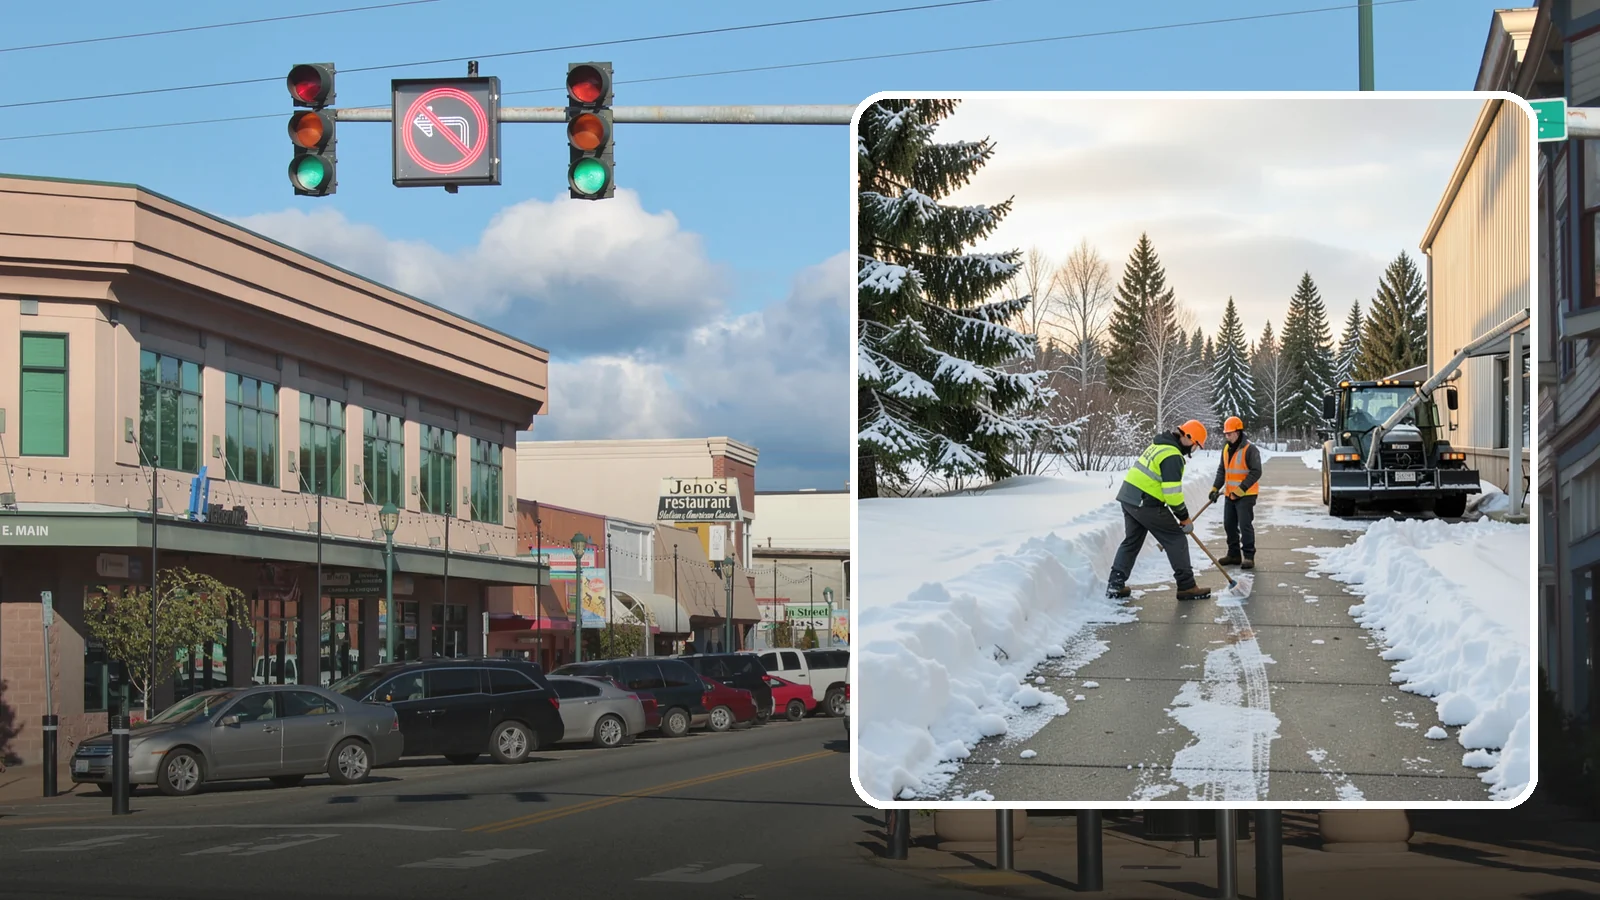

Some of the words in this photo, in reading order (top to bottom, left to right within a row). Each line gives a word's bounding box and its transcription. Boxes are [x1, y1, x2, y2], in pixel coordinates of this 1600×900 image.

[669, 480, 728, 495] Jeno's
[665, 496, 731, 509] restaurant
[658, 510, 682, 520] Italian
[686, 509, 715, 520] American
[715, 509, 738, 520] Cuisine
[1, 525, 13, 536] E.
[15, 525, 49, 536] MAIN
[797, 607, 829, 617] Street
[791, 619, 824, 627] lass
